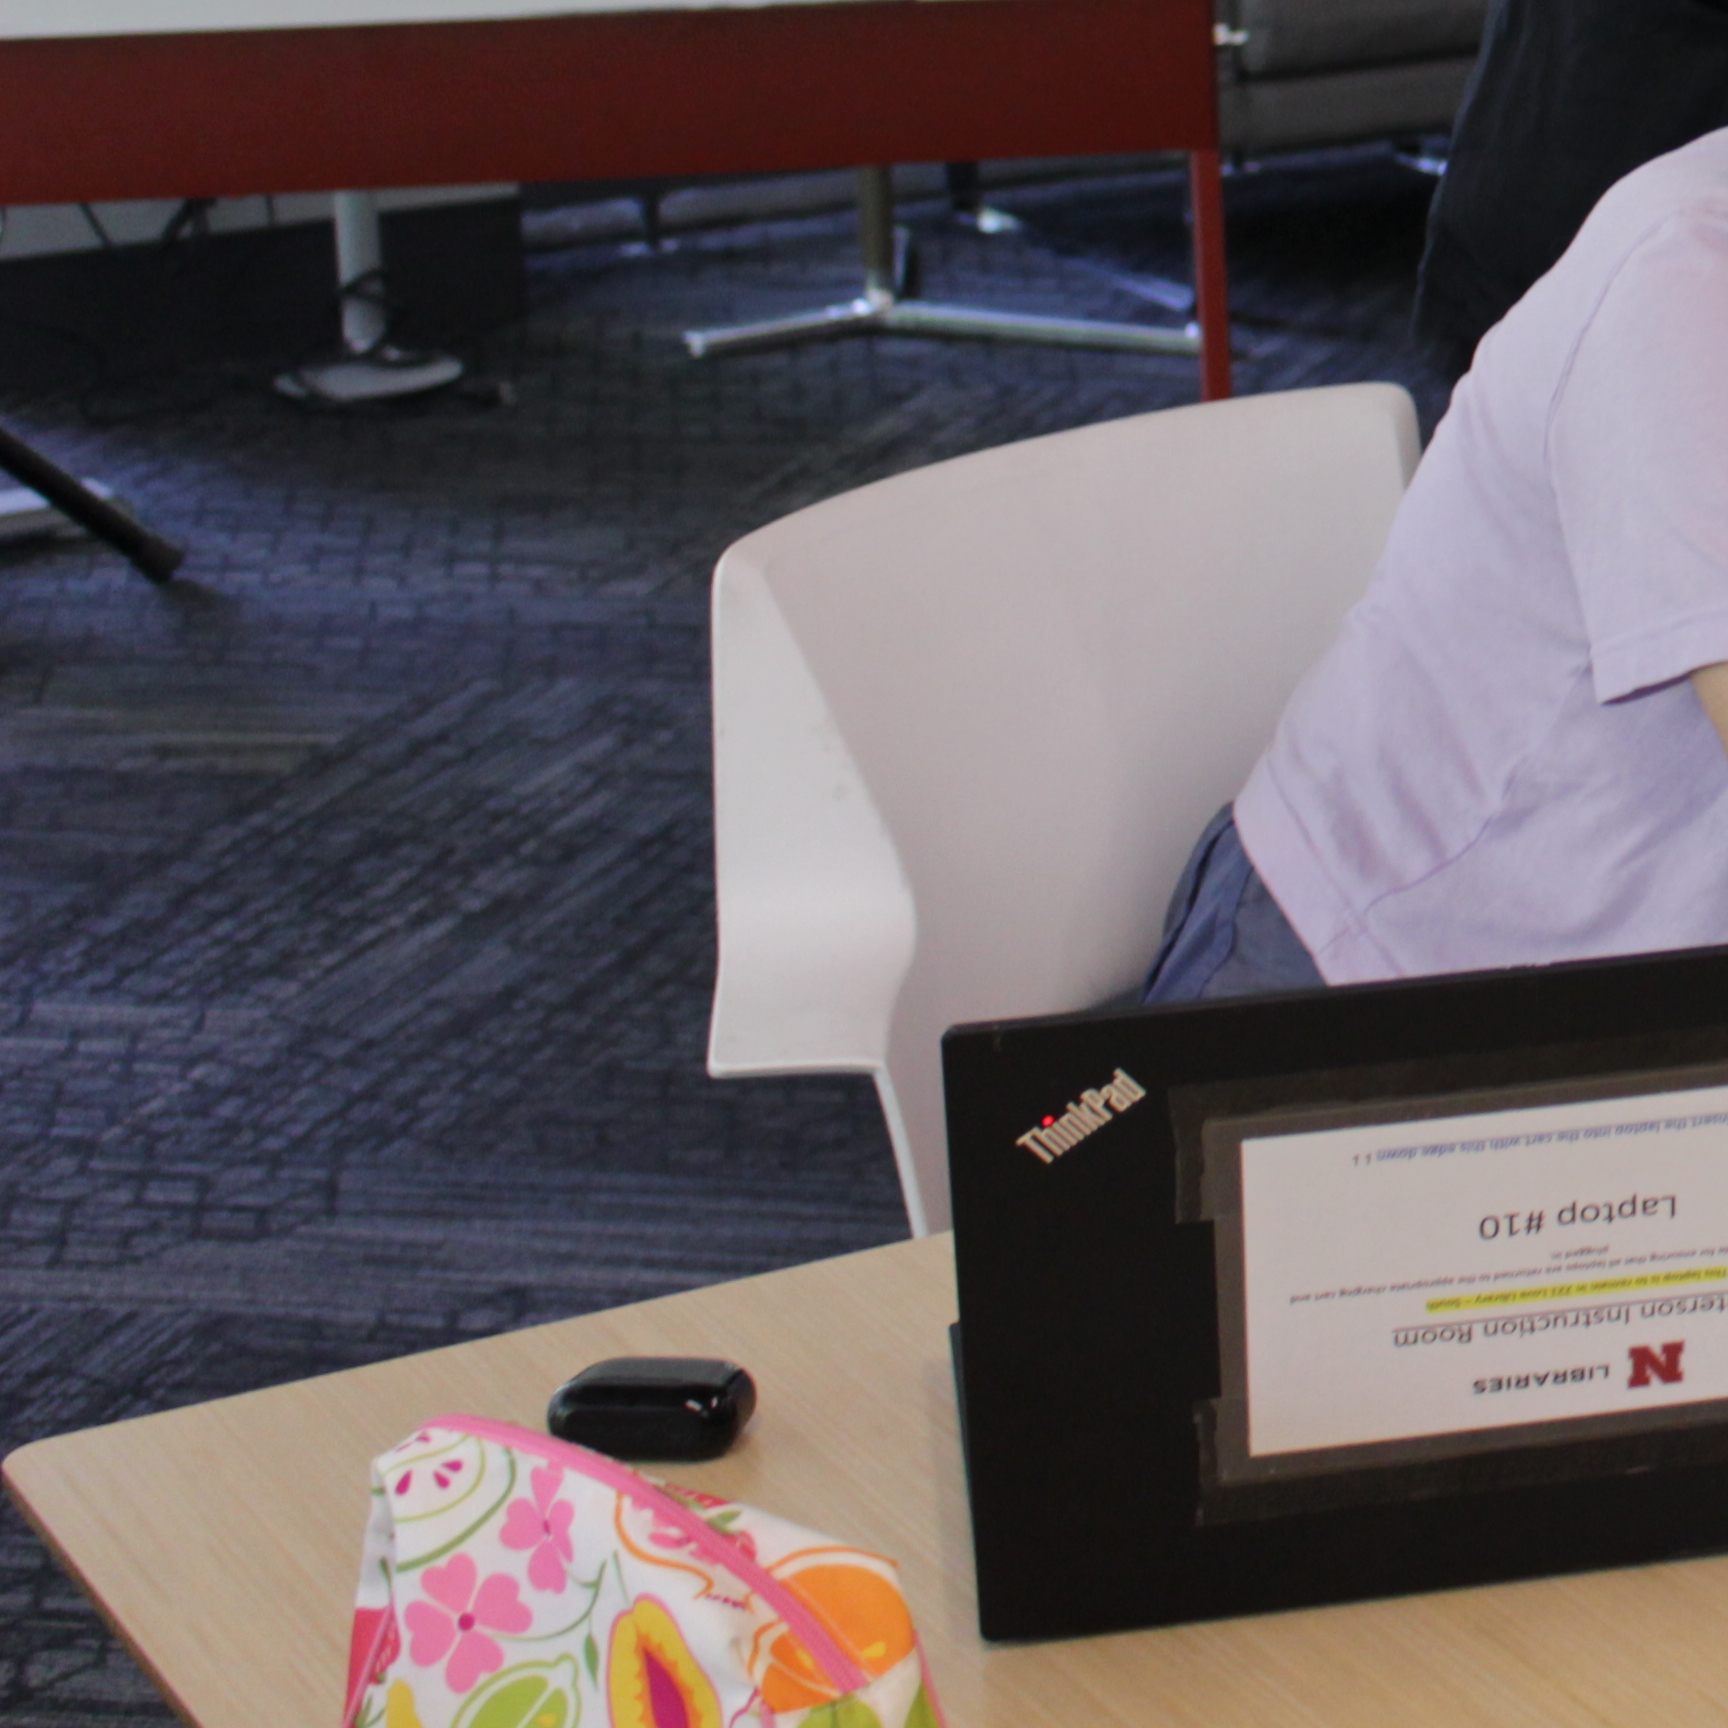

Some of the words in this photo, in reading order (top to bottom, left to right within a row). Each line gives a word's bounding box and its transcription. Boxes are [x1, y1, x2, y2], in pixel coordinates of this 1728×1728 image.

[1014, 1067, 1147, 1164] ThinkPad
[1661, 1115, 1688, 1131] the
[1556, 1127, 1581, 1143] the
[1581, 1124, 1612, 1139] into
[1613, 1118, 1661, 1135] laptop
[1458, 1138, 1485, 1153] this
[1487, 1134, 1521, 1151] with
[1523, 1131, 1553, 1146] cart
[1375, 1146, 1418, 1161] down
[1420, 1142, 1457, 1157] edge
[1556, 1194, 1676, 1225] Laptop
[1478, 1210, 1544, 1239] #10
[1482, 1302, 1630, 1336] Instruction
[1393, 1320, 1472, 1347] Room
[1627, 1341, 1684, 1388] N
[1473, 1364, 1609, 1394] LIBRARIES
